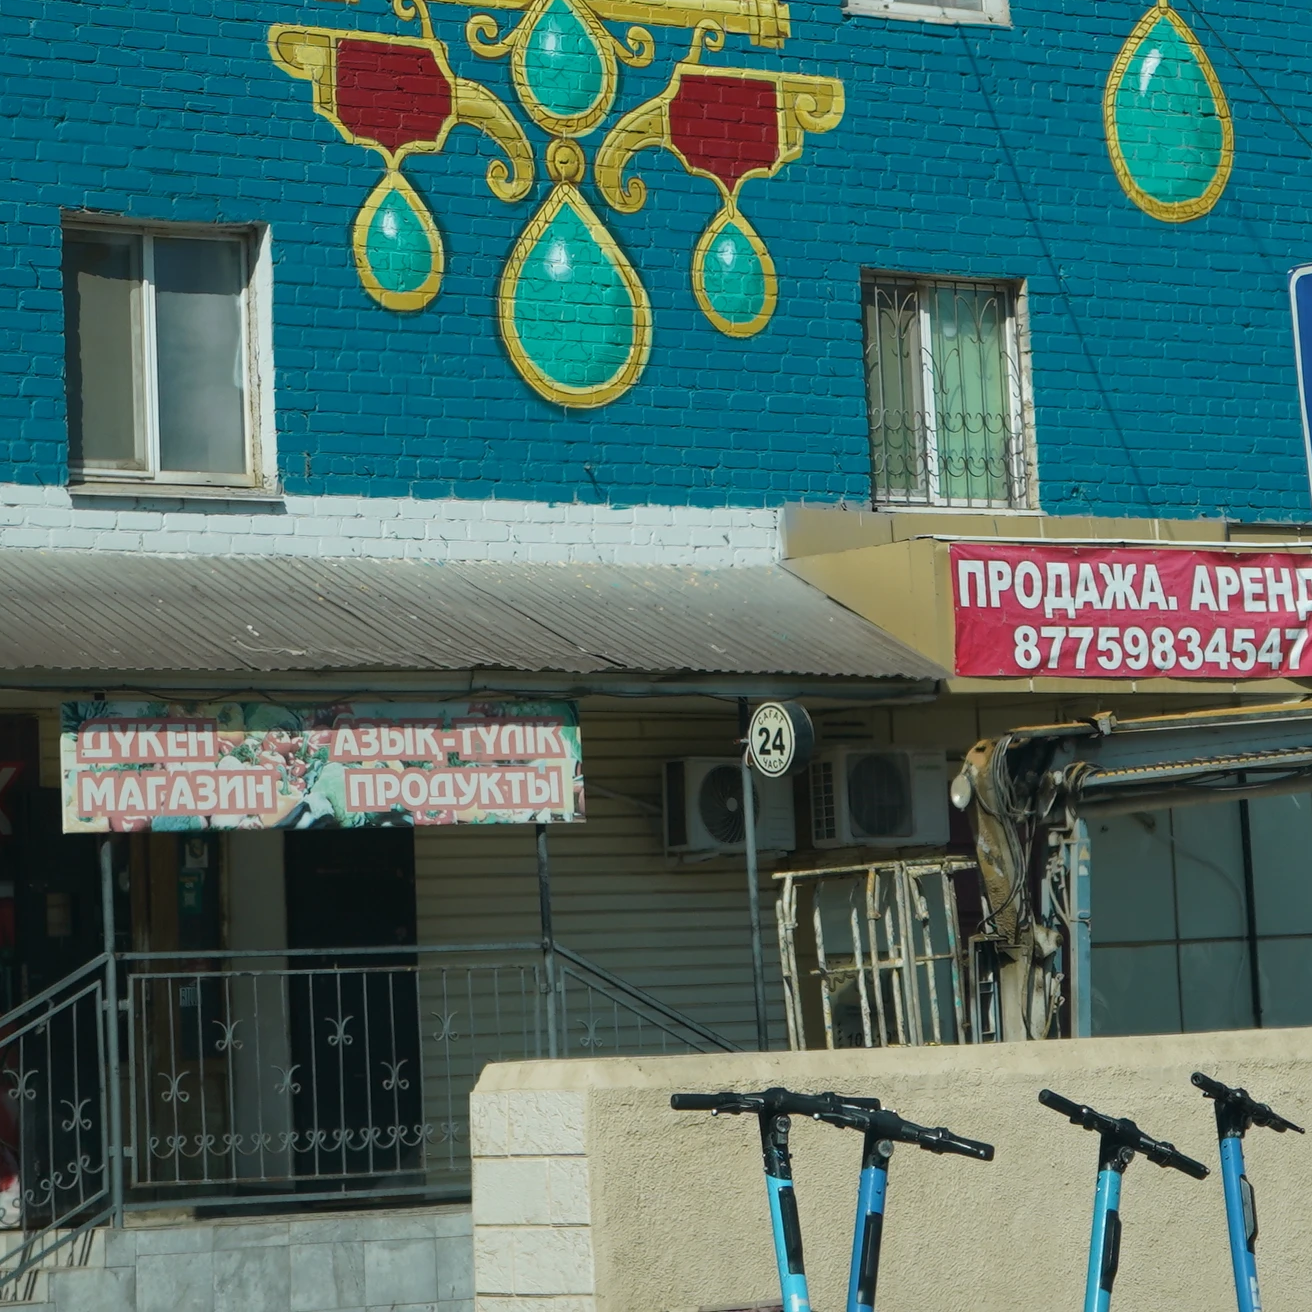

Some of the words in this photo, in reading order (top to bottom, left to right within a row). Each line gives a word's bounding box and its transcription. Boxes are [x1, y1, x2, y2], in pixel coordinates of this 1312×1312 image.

[956, 559, 1179, 619] ПРОДАЖА.
[1013, 624, 1309, 672] 87759834547
[82, 723, 216, 758] ДҮКЕН
[758, 727, 786, 756] 24
[762, 756, 785, 769] ЧАСА
[81, 774, 274, 812] МАГАЗИН
[349, 771, 560, 807] ПРОДУКТЫ
